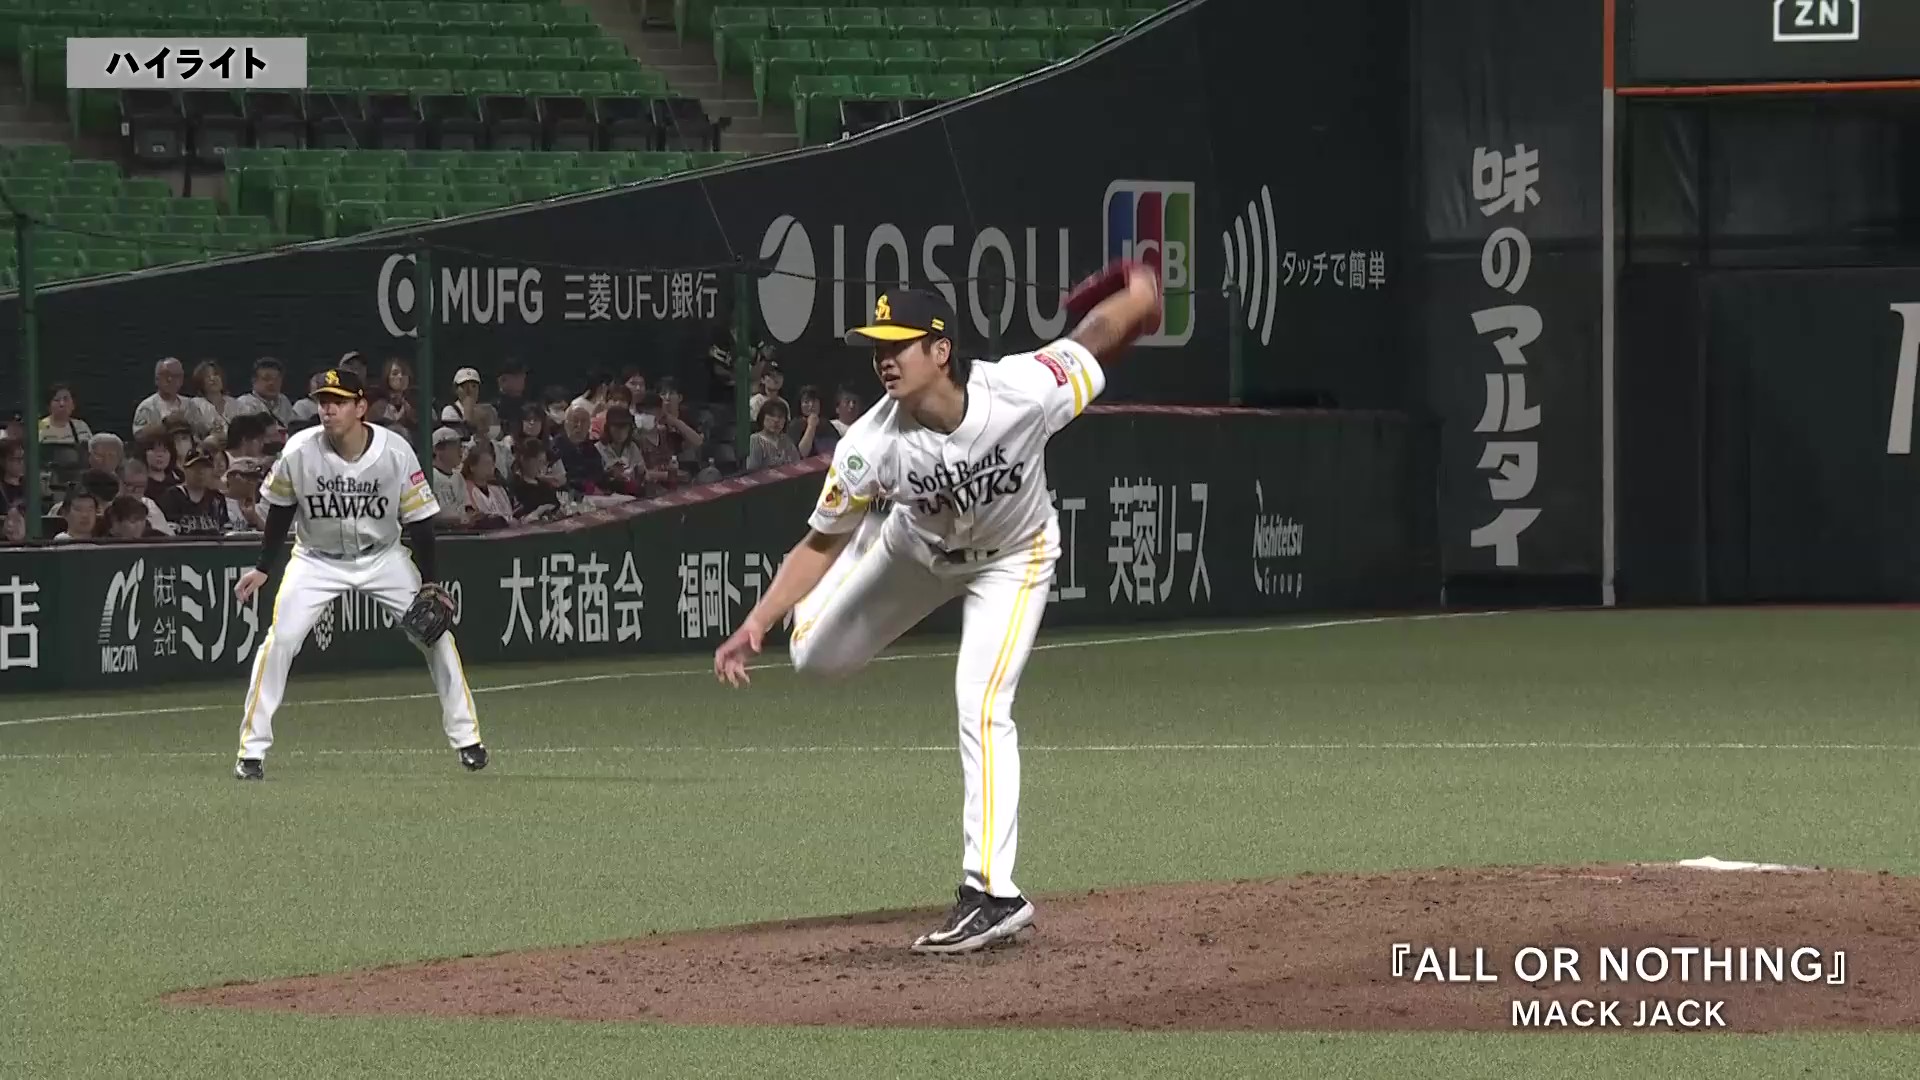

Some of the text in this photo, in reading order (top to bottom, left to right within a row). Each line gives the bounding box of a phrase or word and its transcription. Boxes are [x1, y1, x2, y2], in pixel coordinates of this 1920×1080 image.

[564, 270, 718, 320] 三菱UFJ銀行
[1282, 250, 1386, 290] タッチで簡単
[441, 267, 543, 324] MUFG
[1471, 143, 1543, 566] 味のマルタイ
[317, 475, 381, 495] SoftBank
[907, 444, 1008, 494] SoftBank
[305, 494, 389, 520] HAWKS
[1107, 476, 1211, 605] 芙蓉リース
[1253, 514, 1304, 558] Nishitetsu
[500, 551, 644, 646] 大塚商会
[1264, 567, 1303, 598] Group
[0, 575, 40, 669] 店
